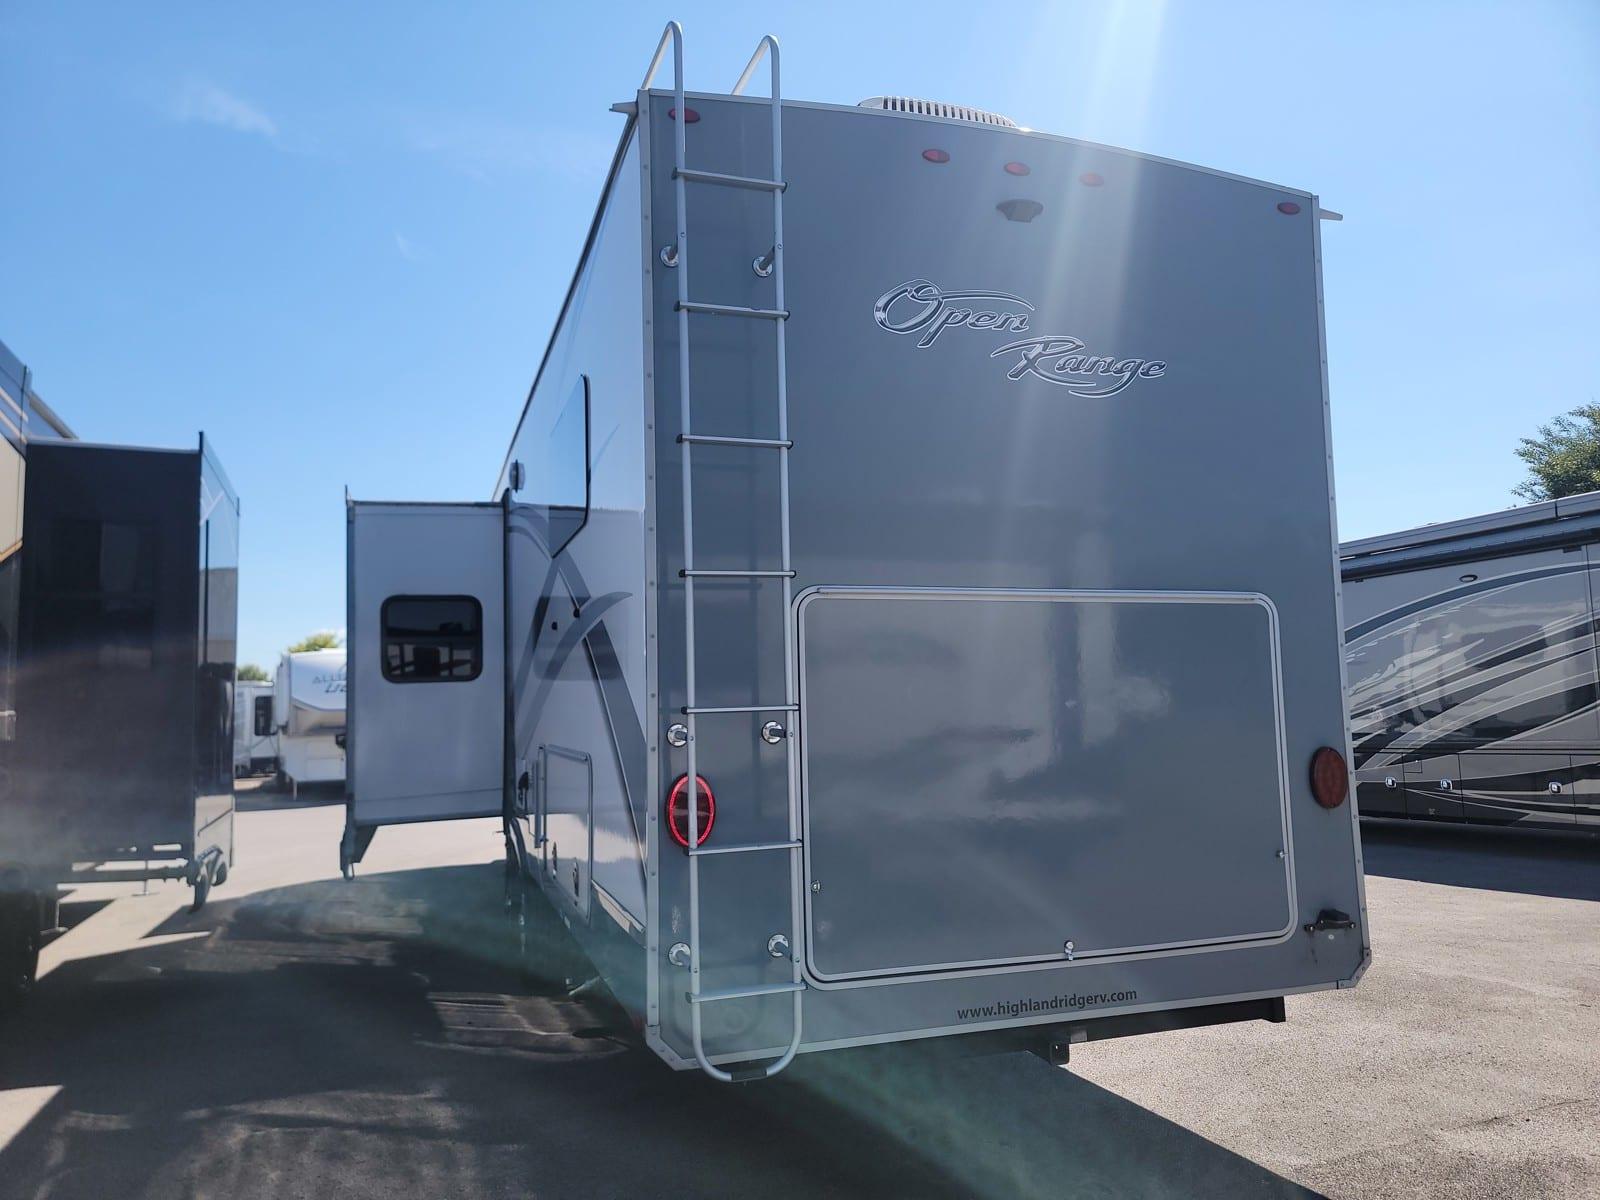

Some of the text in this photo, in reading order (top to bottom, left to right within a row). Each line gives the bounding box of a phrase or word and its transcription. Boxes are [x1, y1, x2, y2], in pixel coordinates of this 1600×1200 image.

[873, 278, 1035, 348] Open
[991, 335, 1167, 398] Range
[957, 990, 1137, 1020] www.highlandridgerv.com
